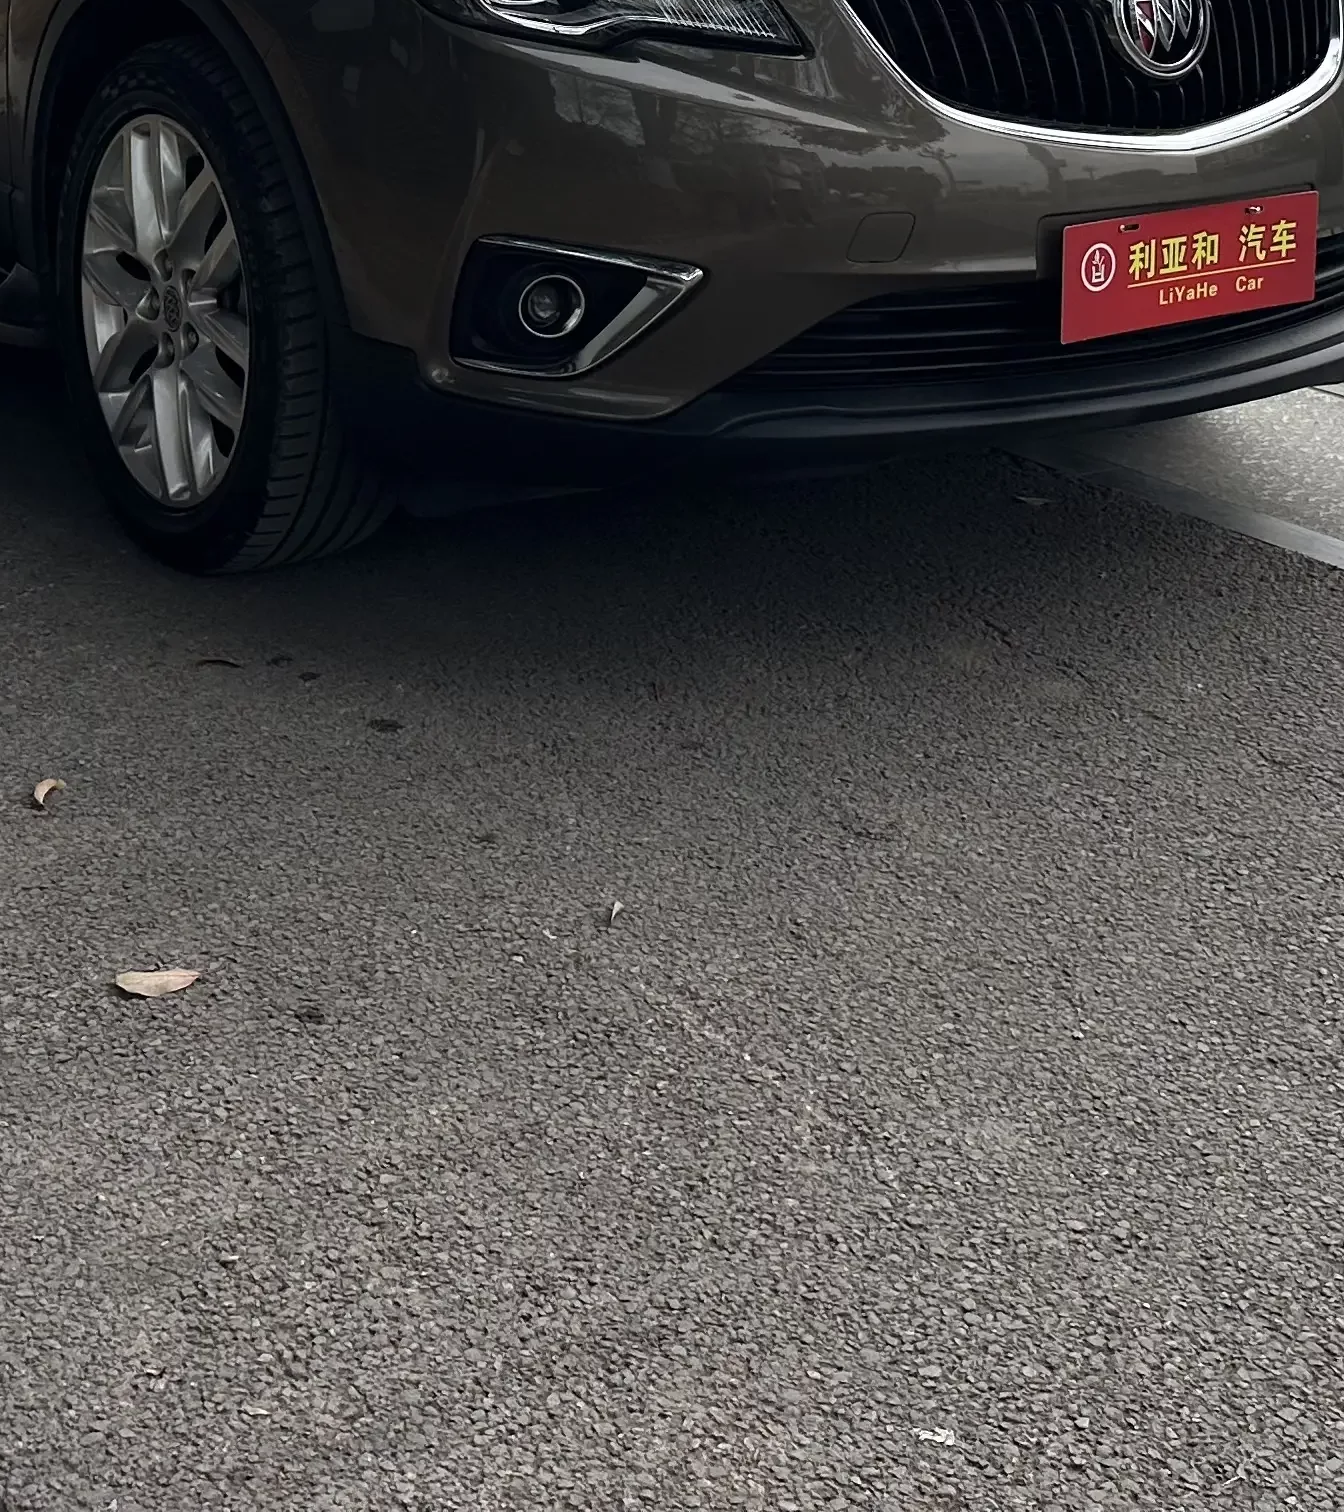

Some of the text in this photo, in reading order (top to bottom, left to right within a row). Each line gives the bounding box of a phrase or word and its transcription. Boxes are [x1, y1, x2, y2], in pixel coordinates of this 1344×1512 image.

[1128, 219, 1297, 280] 利亚和 汽车
[1159, 276, 1264, 305] LiYaHe Car
